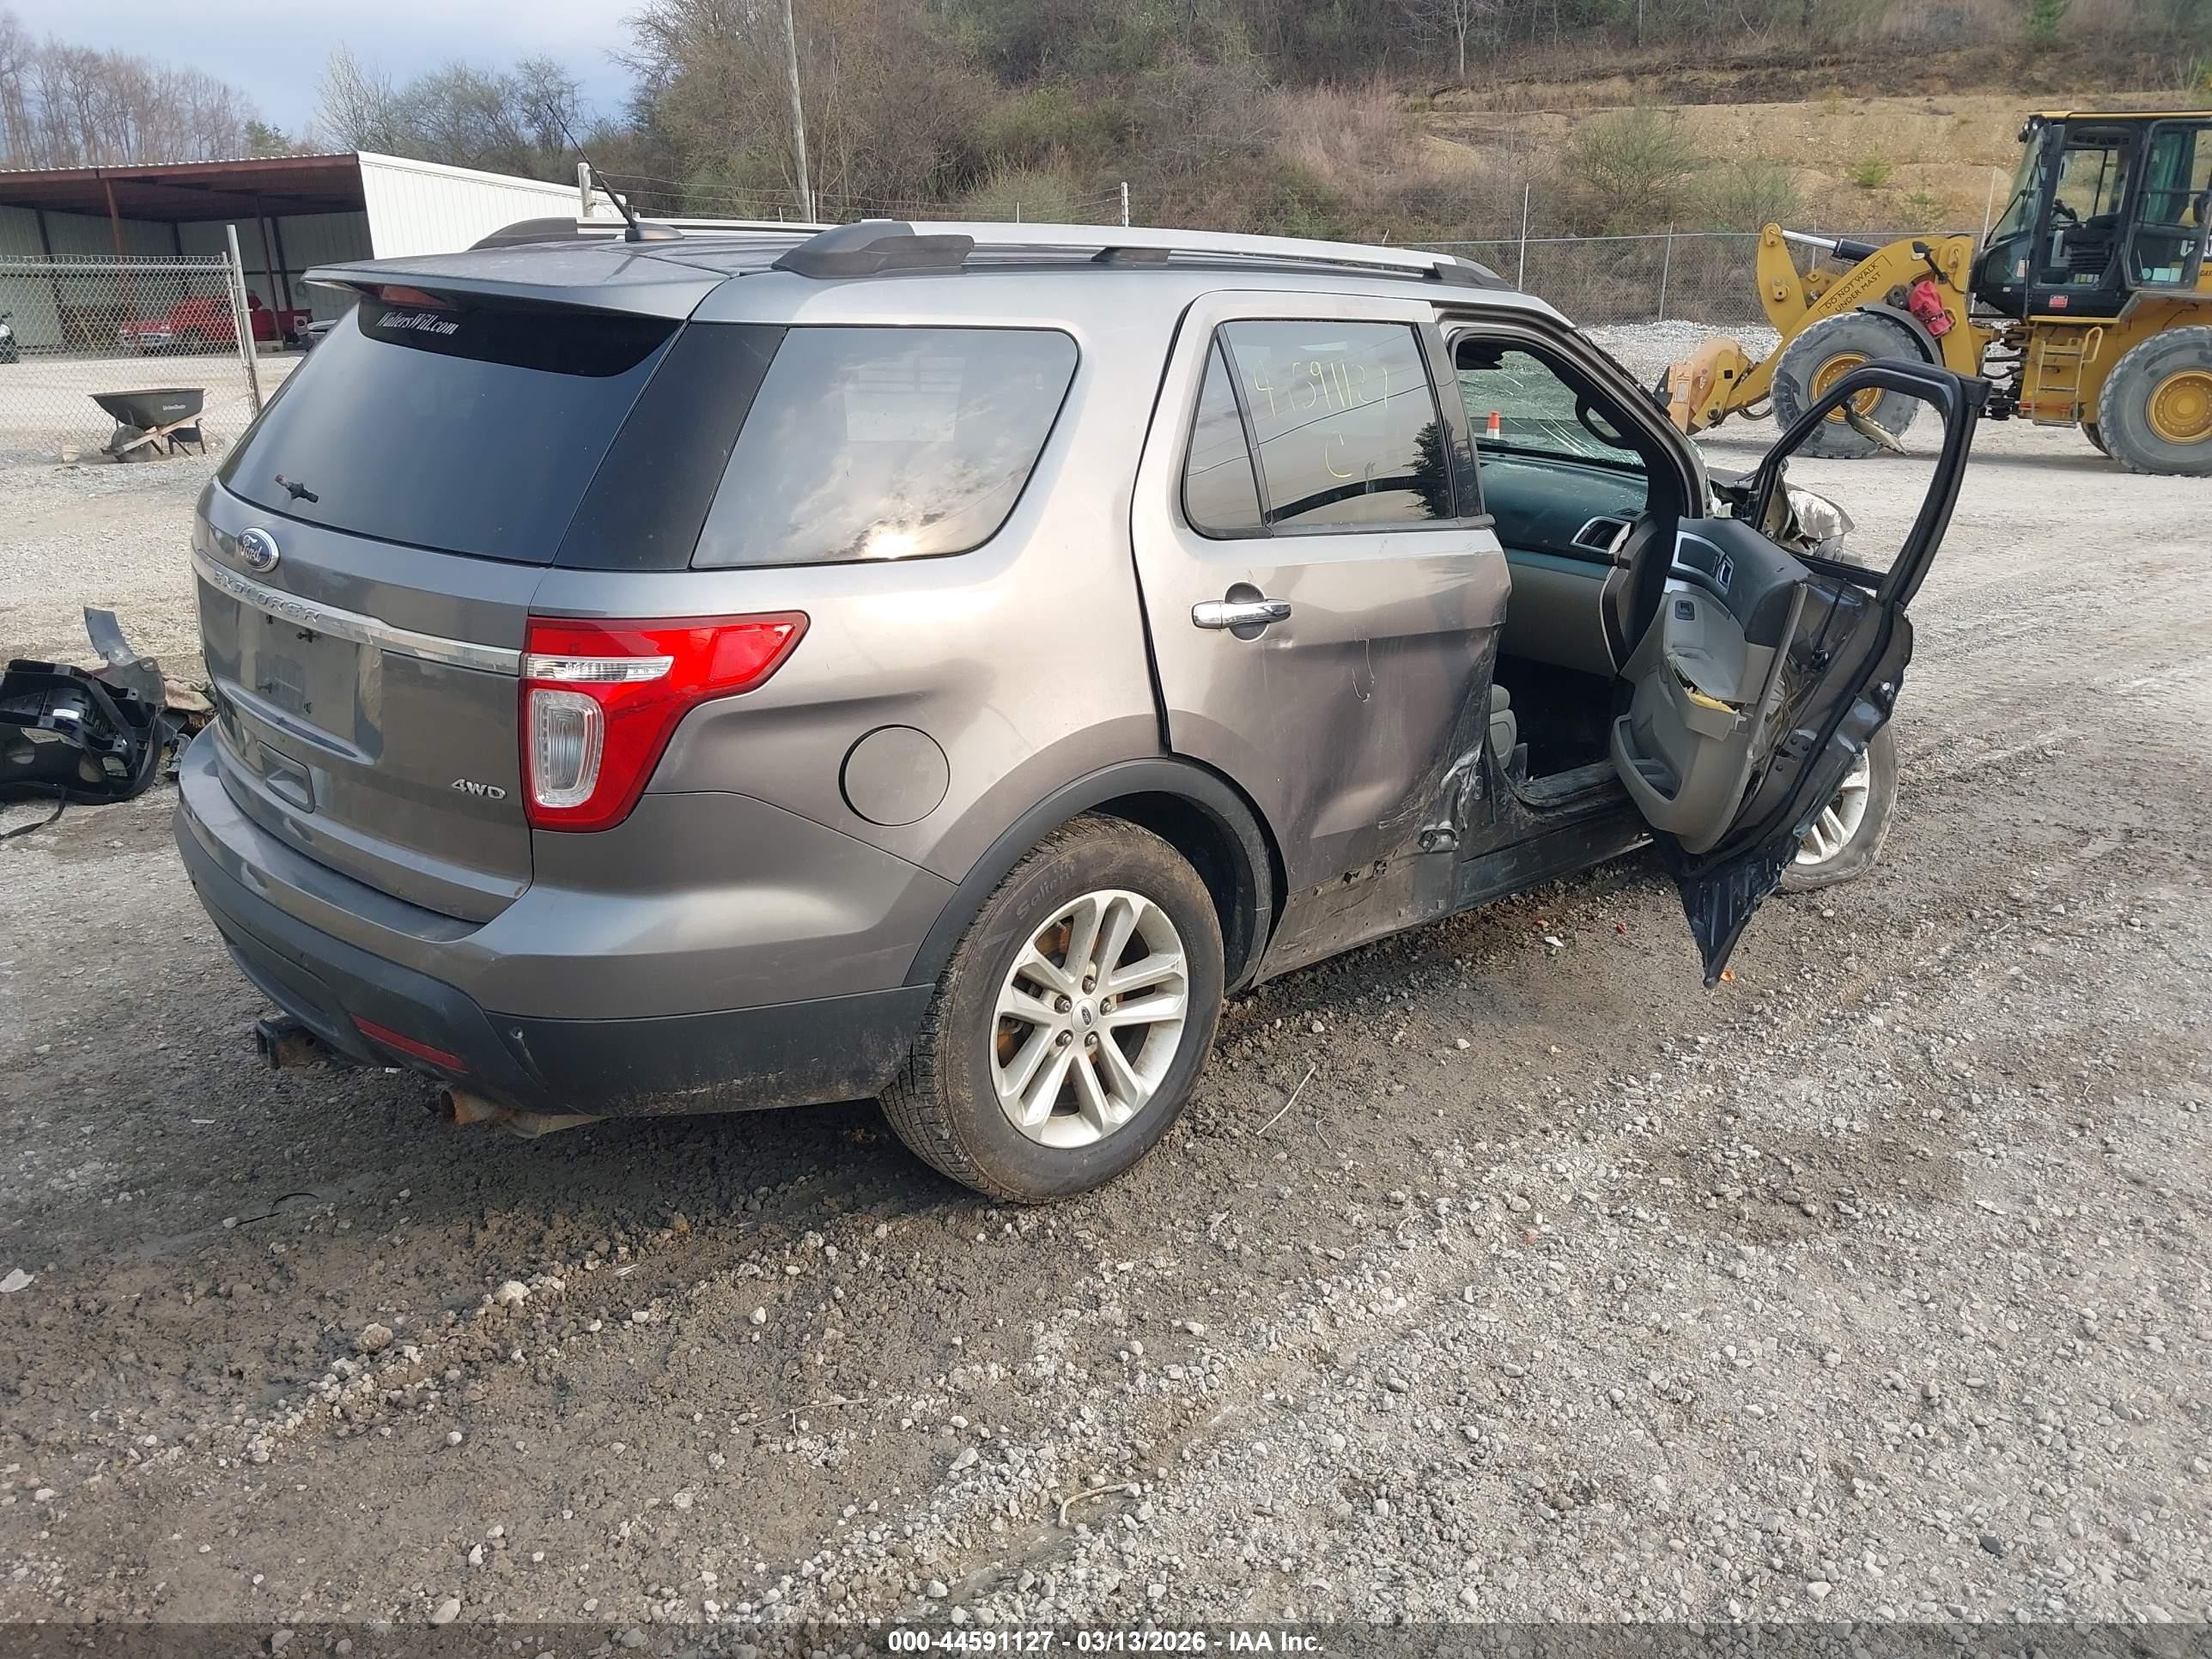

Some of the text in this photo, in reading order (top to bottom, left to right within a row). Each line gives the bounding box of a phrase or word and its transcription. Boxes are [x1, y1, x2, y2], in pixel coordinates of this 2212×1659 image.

[1825, 263, 1879, 309] DO NOT WALK
[1835, 271, 1881, 313] UNDER MAST
[240, 534, 263, 562] Ford
[213, 570, 321, 623] EXPLORER
[451, 778, 507, 799] 4WD
